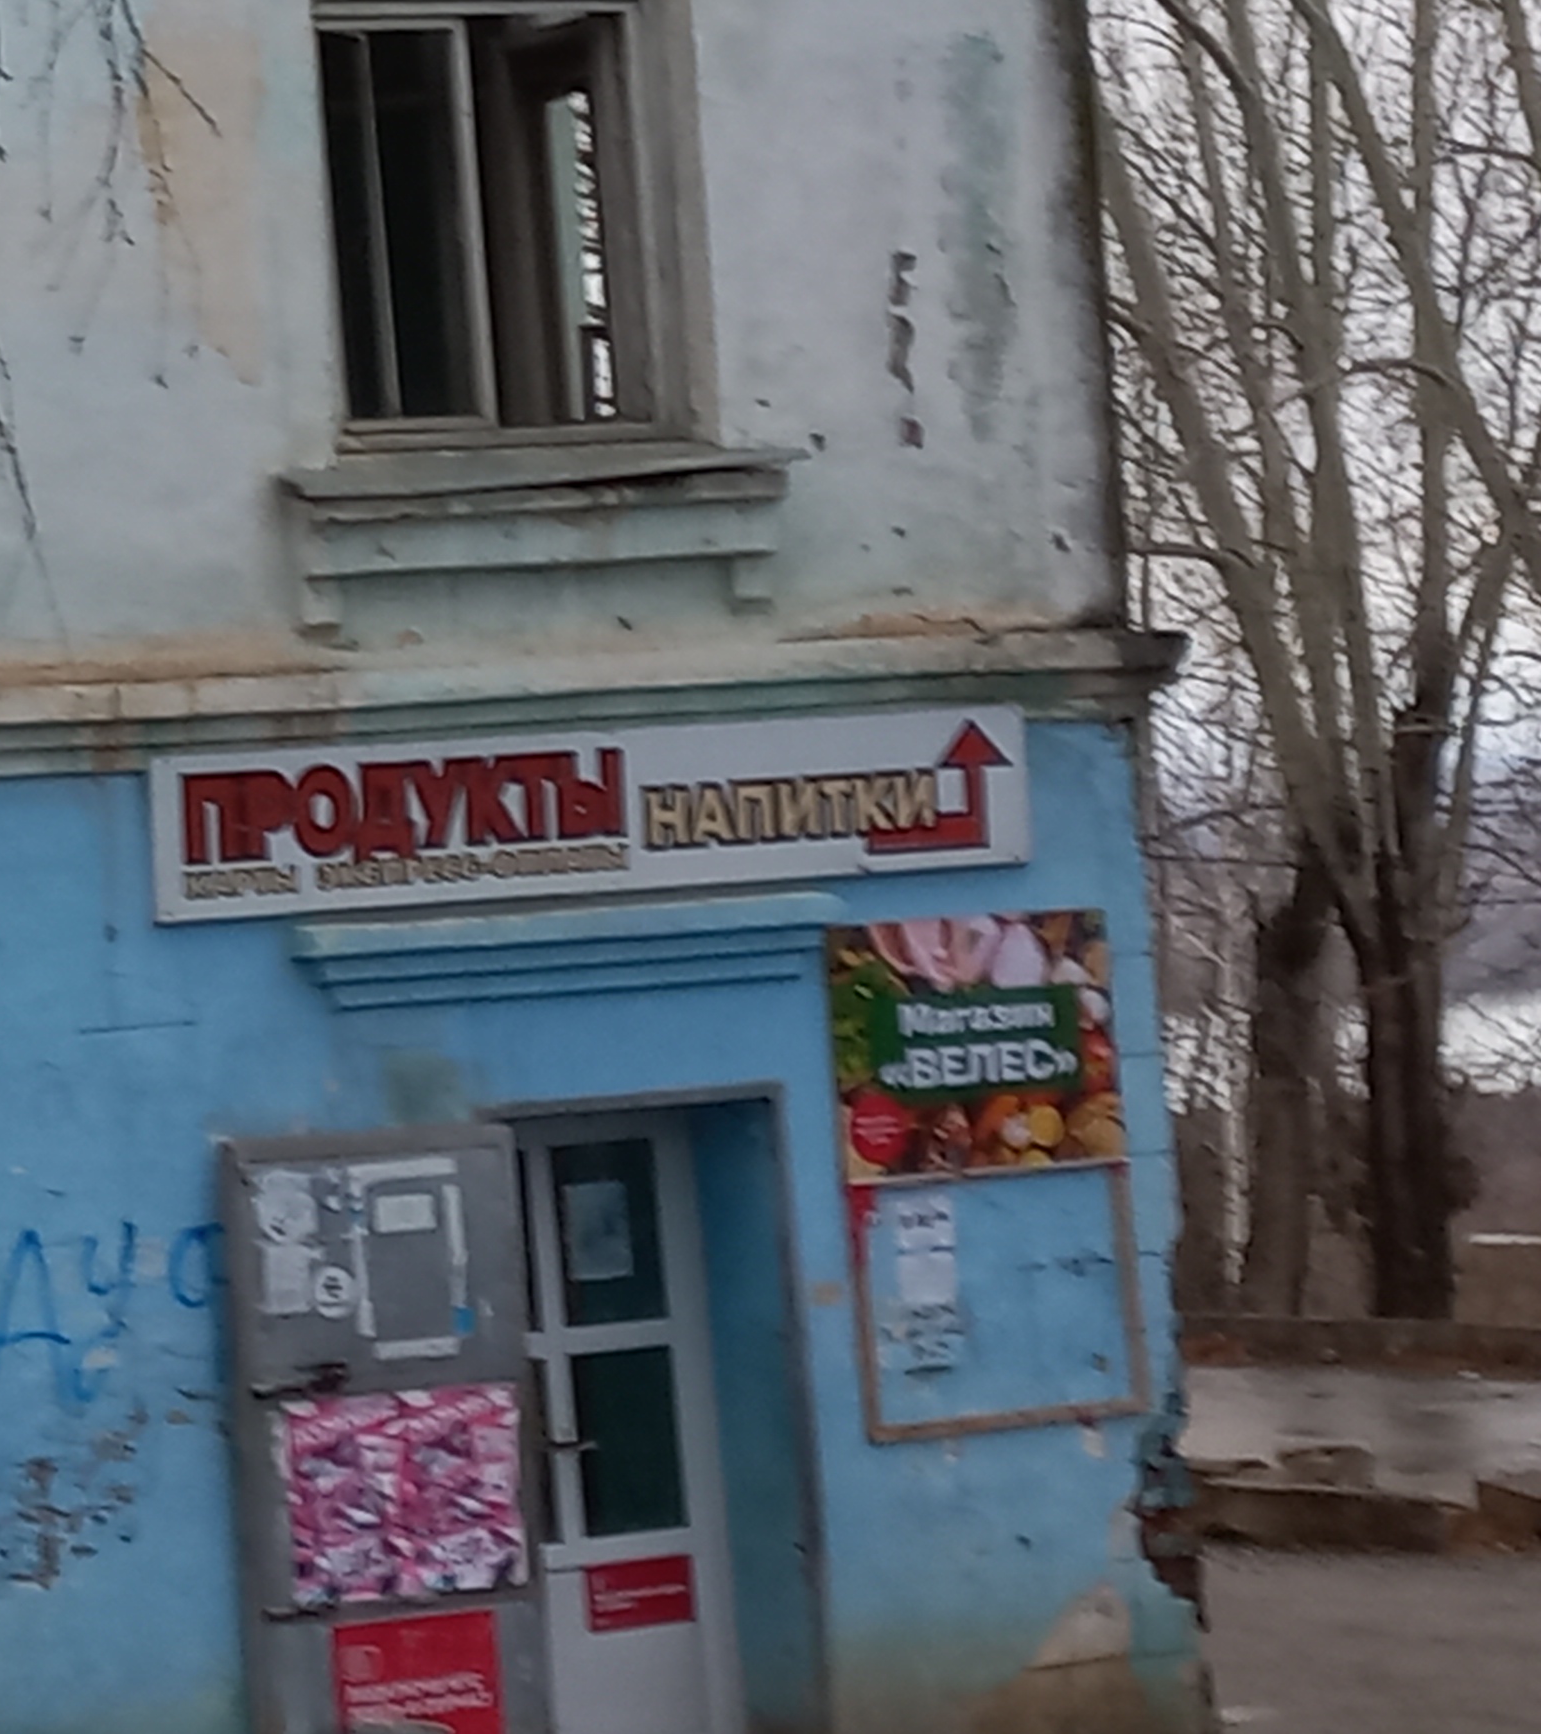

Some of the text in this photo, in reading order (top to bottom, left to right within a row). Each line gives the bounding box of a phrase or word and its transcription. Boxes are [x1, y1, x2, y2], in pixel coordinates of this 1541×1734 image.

[179, 747, 938, 866] ПРОДУКТЫ НАПИТКИ
[896, 1002, 1055, 1038] Магазин
